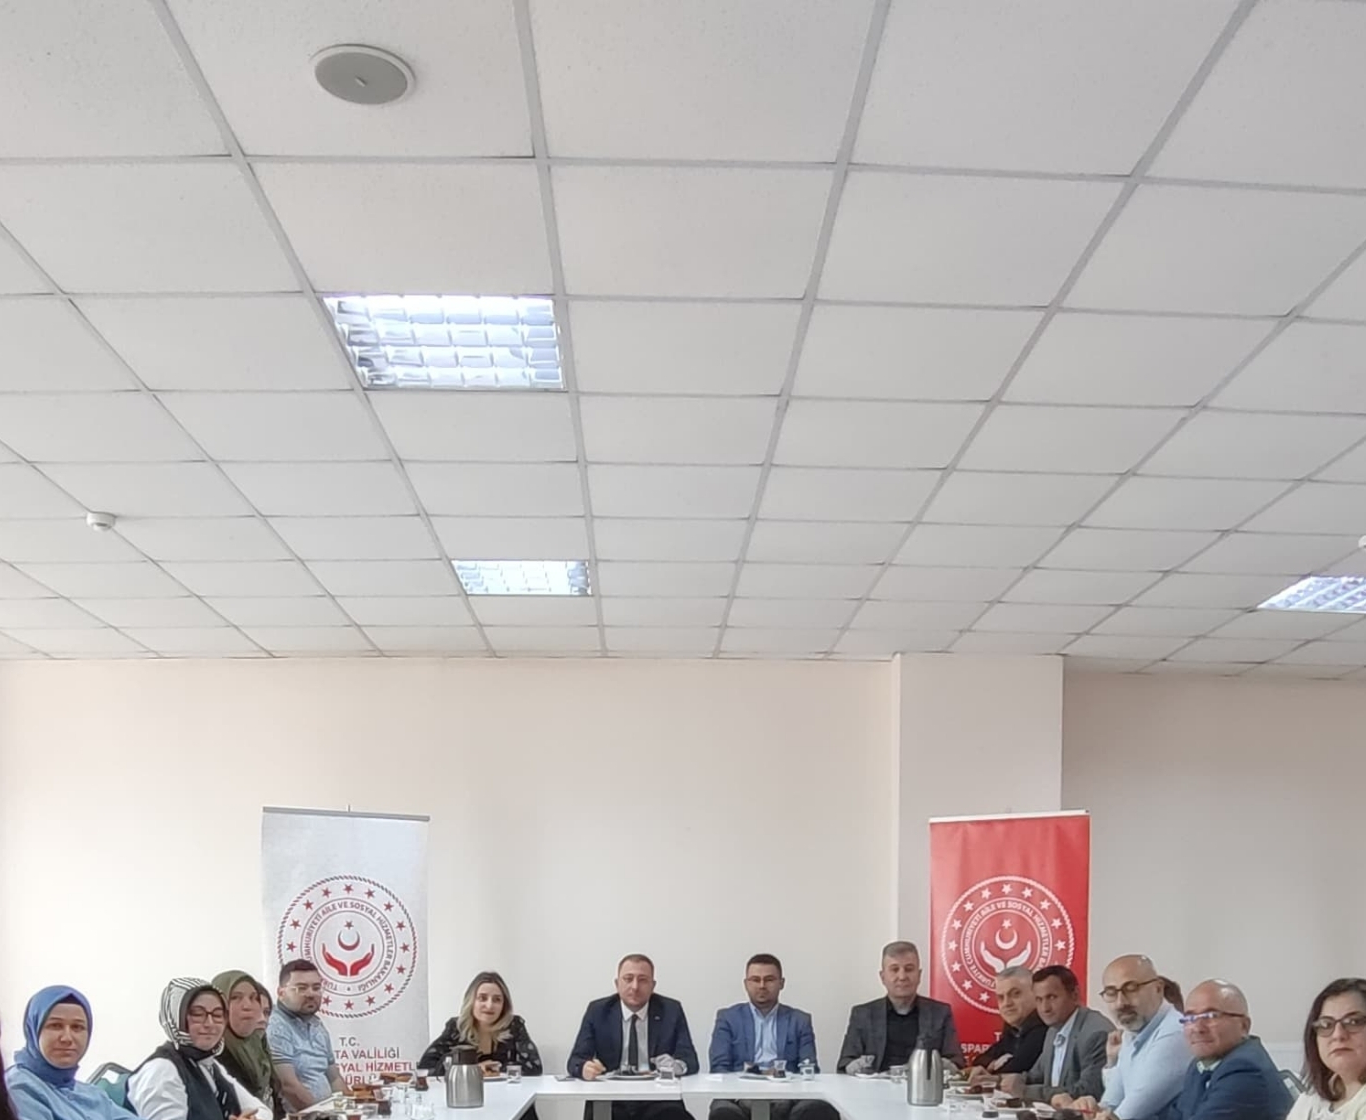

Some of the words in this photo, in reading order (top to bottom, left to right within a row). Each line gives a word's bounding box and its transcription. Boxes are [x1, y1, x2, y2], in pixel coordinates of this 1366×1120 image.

[303, 912, 322, 962] UMHURİYETİ
[319, 902, 338, 917] AİLE
[336, 900, 348, 909] VE
[349, 900, 379, 918] SOSYAL
[376, 914, 394, 960] HİZMETLER
[339, 1036, 360, 1047] T.C.
[351, 1047, 400, 1059] VALİLİĞİ
[366, 1060, 417, 1072] HİZMETL
